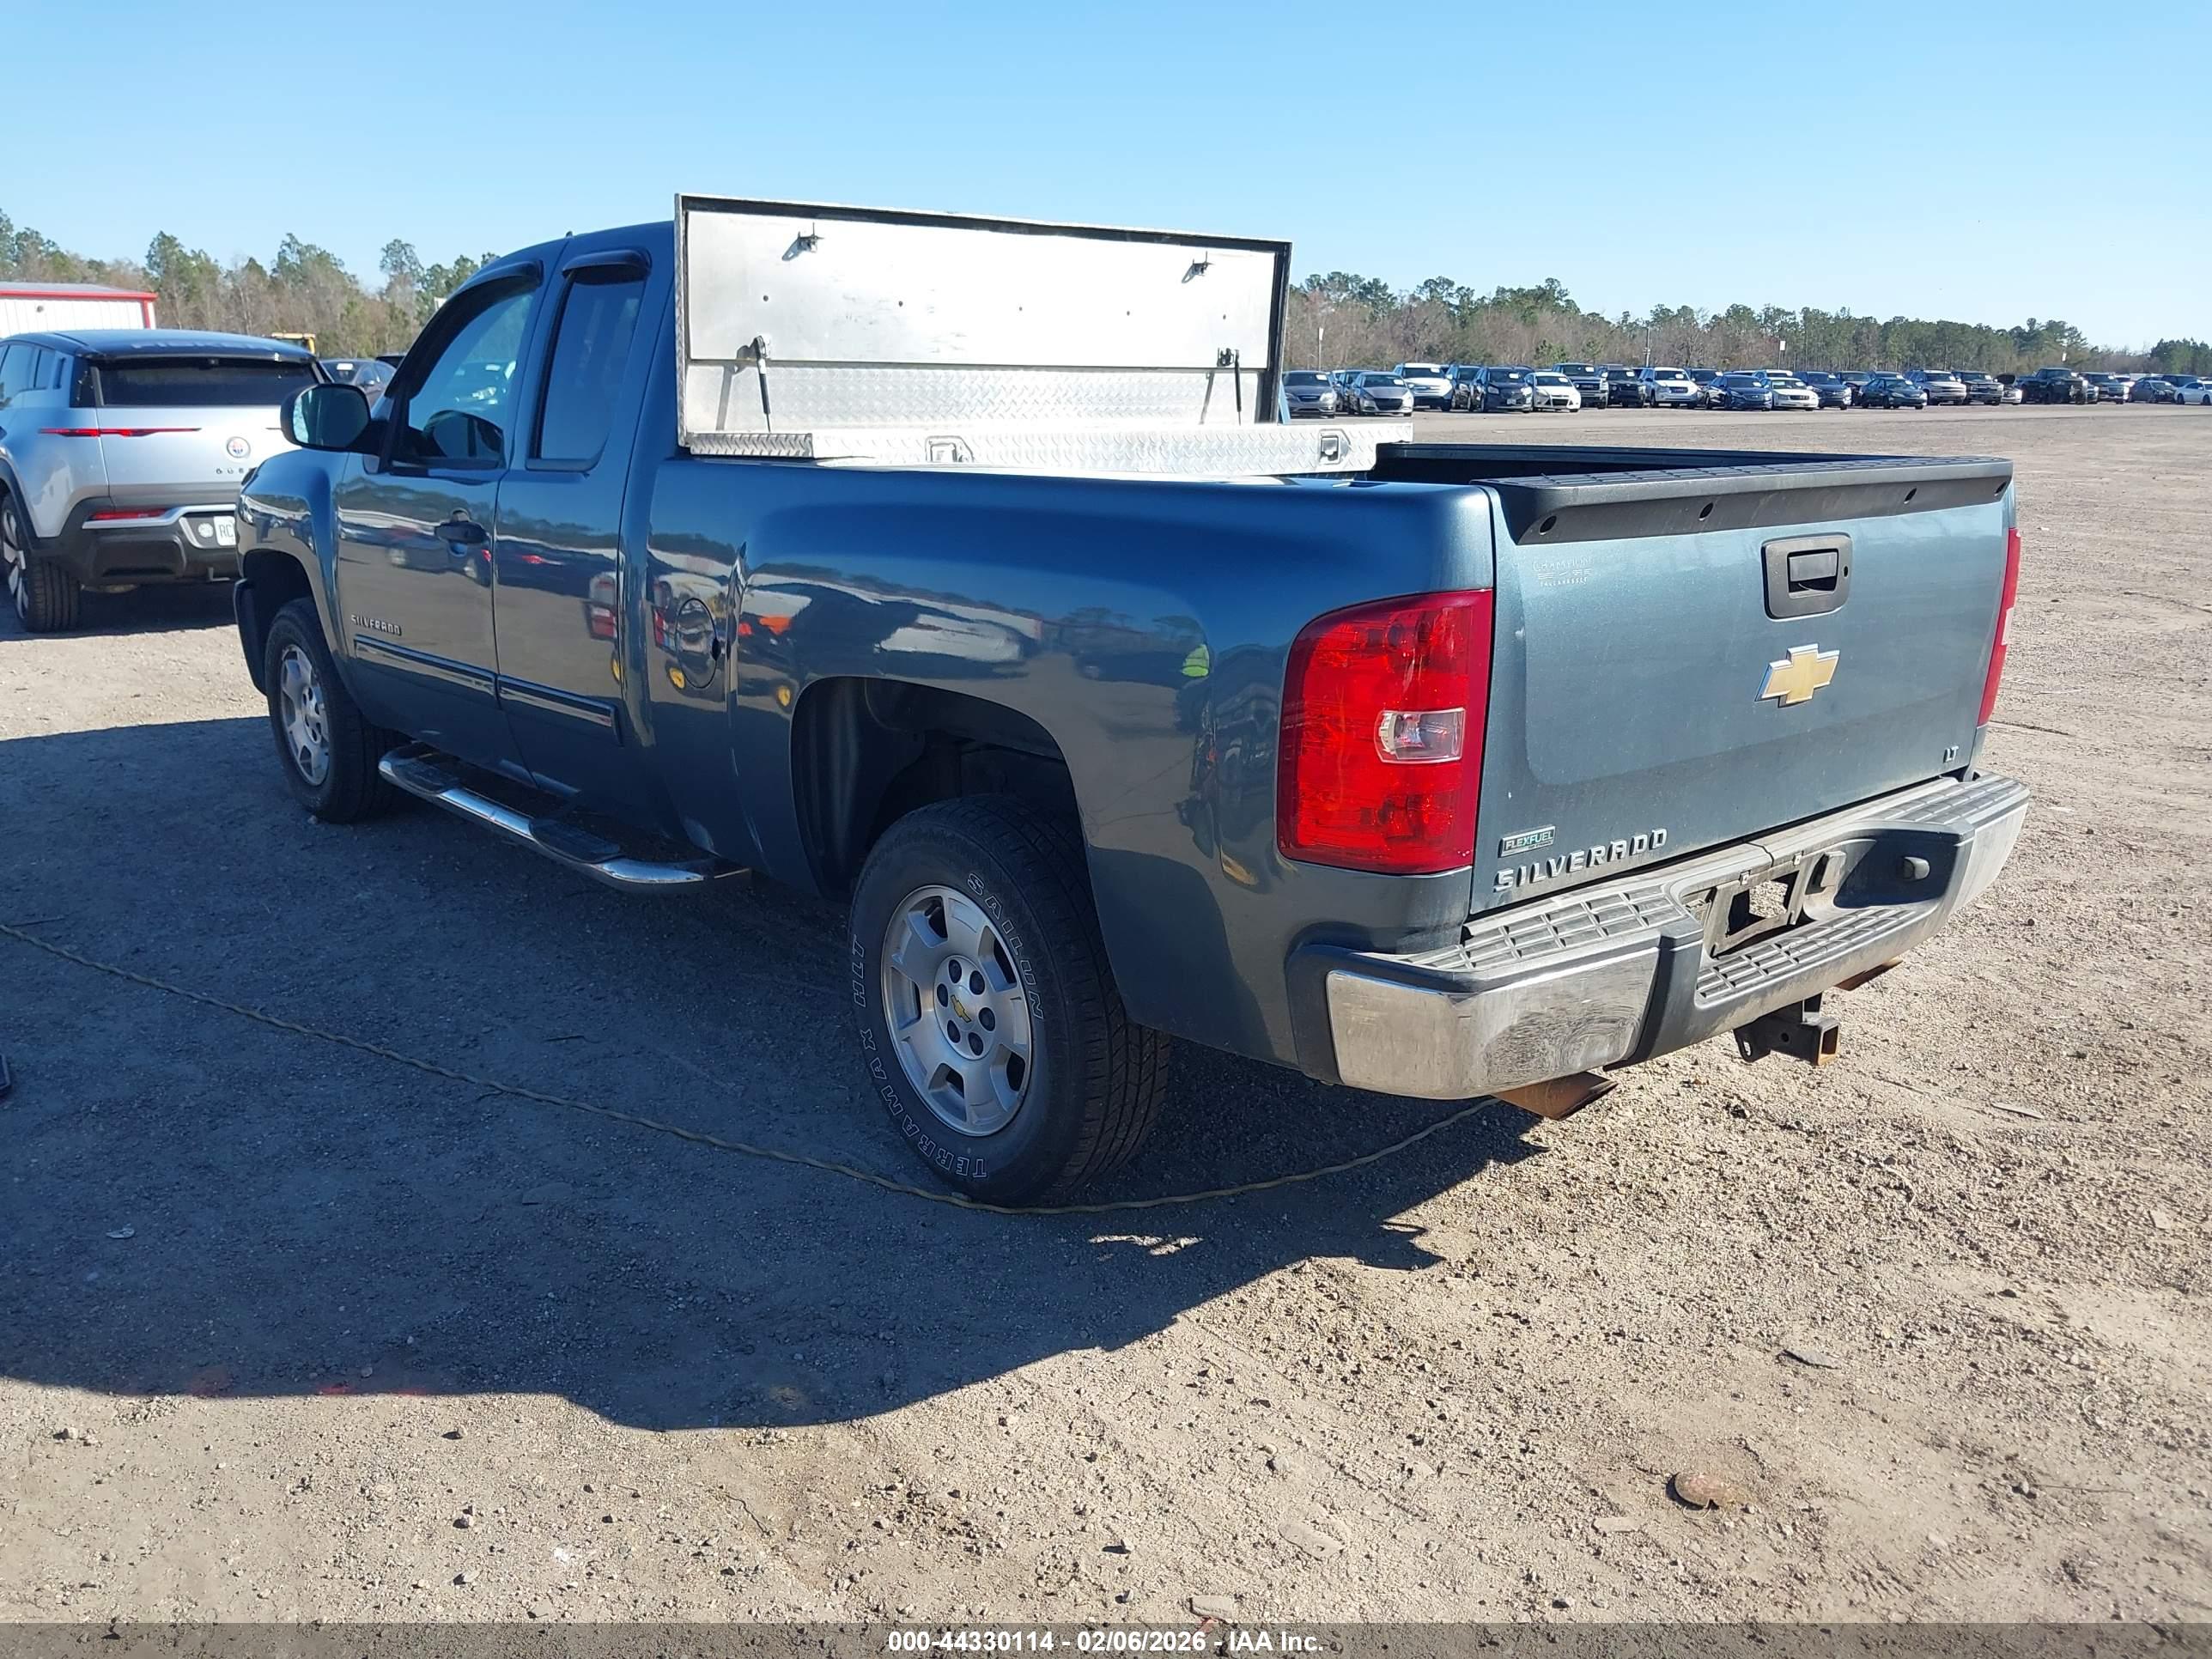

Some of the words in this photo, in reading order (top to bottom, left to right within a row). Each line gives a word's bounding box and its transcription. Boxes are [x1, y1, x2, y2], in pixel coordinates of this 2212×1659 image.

[350, 614, 401, 636] SILVERADO
[1943, 745, 1959, 763] LT
[1493, 828, 1668, 892] SILVERADO
[1505, 831, 1553, 850] FLEXFUEL
[852, 934, 866, 1007] HLT
[967, 872, 1043, 1019] SAILUN
[860, 1029, 988, 1178] TERRAMAX
